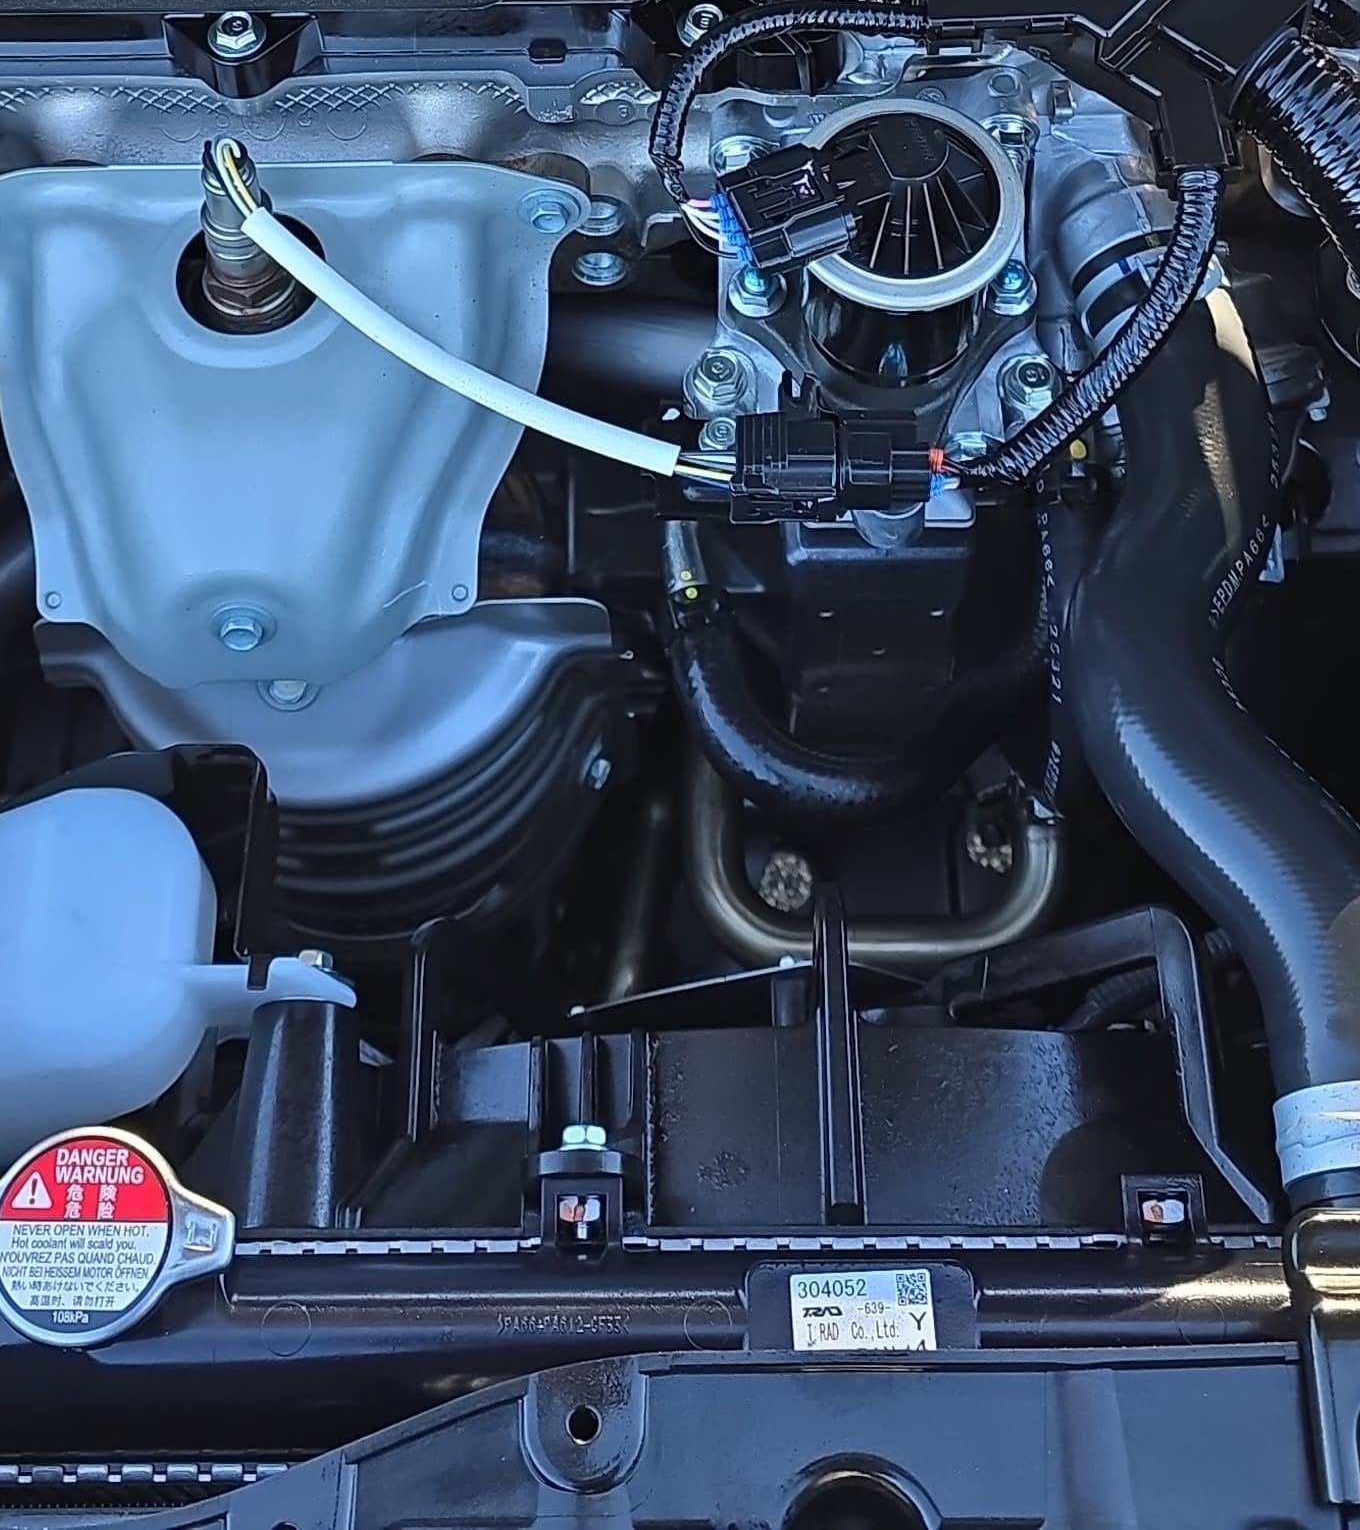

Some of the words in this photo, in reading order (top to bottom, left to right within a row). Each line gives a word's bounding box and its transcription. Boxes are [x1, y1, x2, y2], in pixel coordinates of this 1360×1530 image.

[57, 1148, 128, 1166] DANGER
[56, 1166, 143, 1184] WARNUNG
[13, 1225, 52, 1236] NEVER
[54, 1225, 86, 1236] OPEN
[88, 1225, 122, 1236] WHEN
[124, 1225, 150, 1237] HOT.
[11, 1238, 30, 1249] Hot
[32, 1238, 67, 1249] coolant
[68, 1238, 86, 1248] will
[88, 1238, 114, 1249] scald
[117, 1240, 136, 1251] you.
[0, 1252, 52, 1264] N'OUVREZ
[54, 1252, 75, 1263] PAS
[77, 1252, 115, 1264] QUAND
[2, 1266, 27, 1278] NICHT
[29, 1266, 43, 1278] BEI
[44, 1266, 80, 1278] HEISSEM
[82, 1266, 112, 1278] MOTOR
[797, 1279, 867, 1300] 304052
[857, 1303, 891, 1315] -639-
[52, 1311, 89, 1324] 108kPa
[909, 1312, 927, 1331] Y
